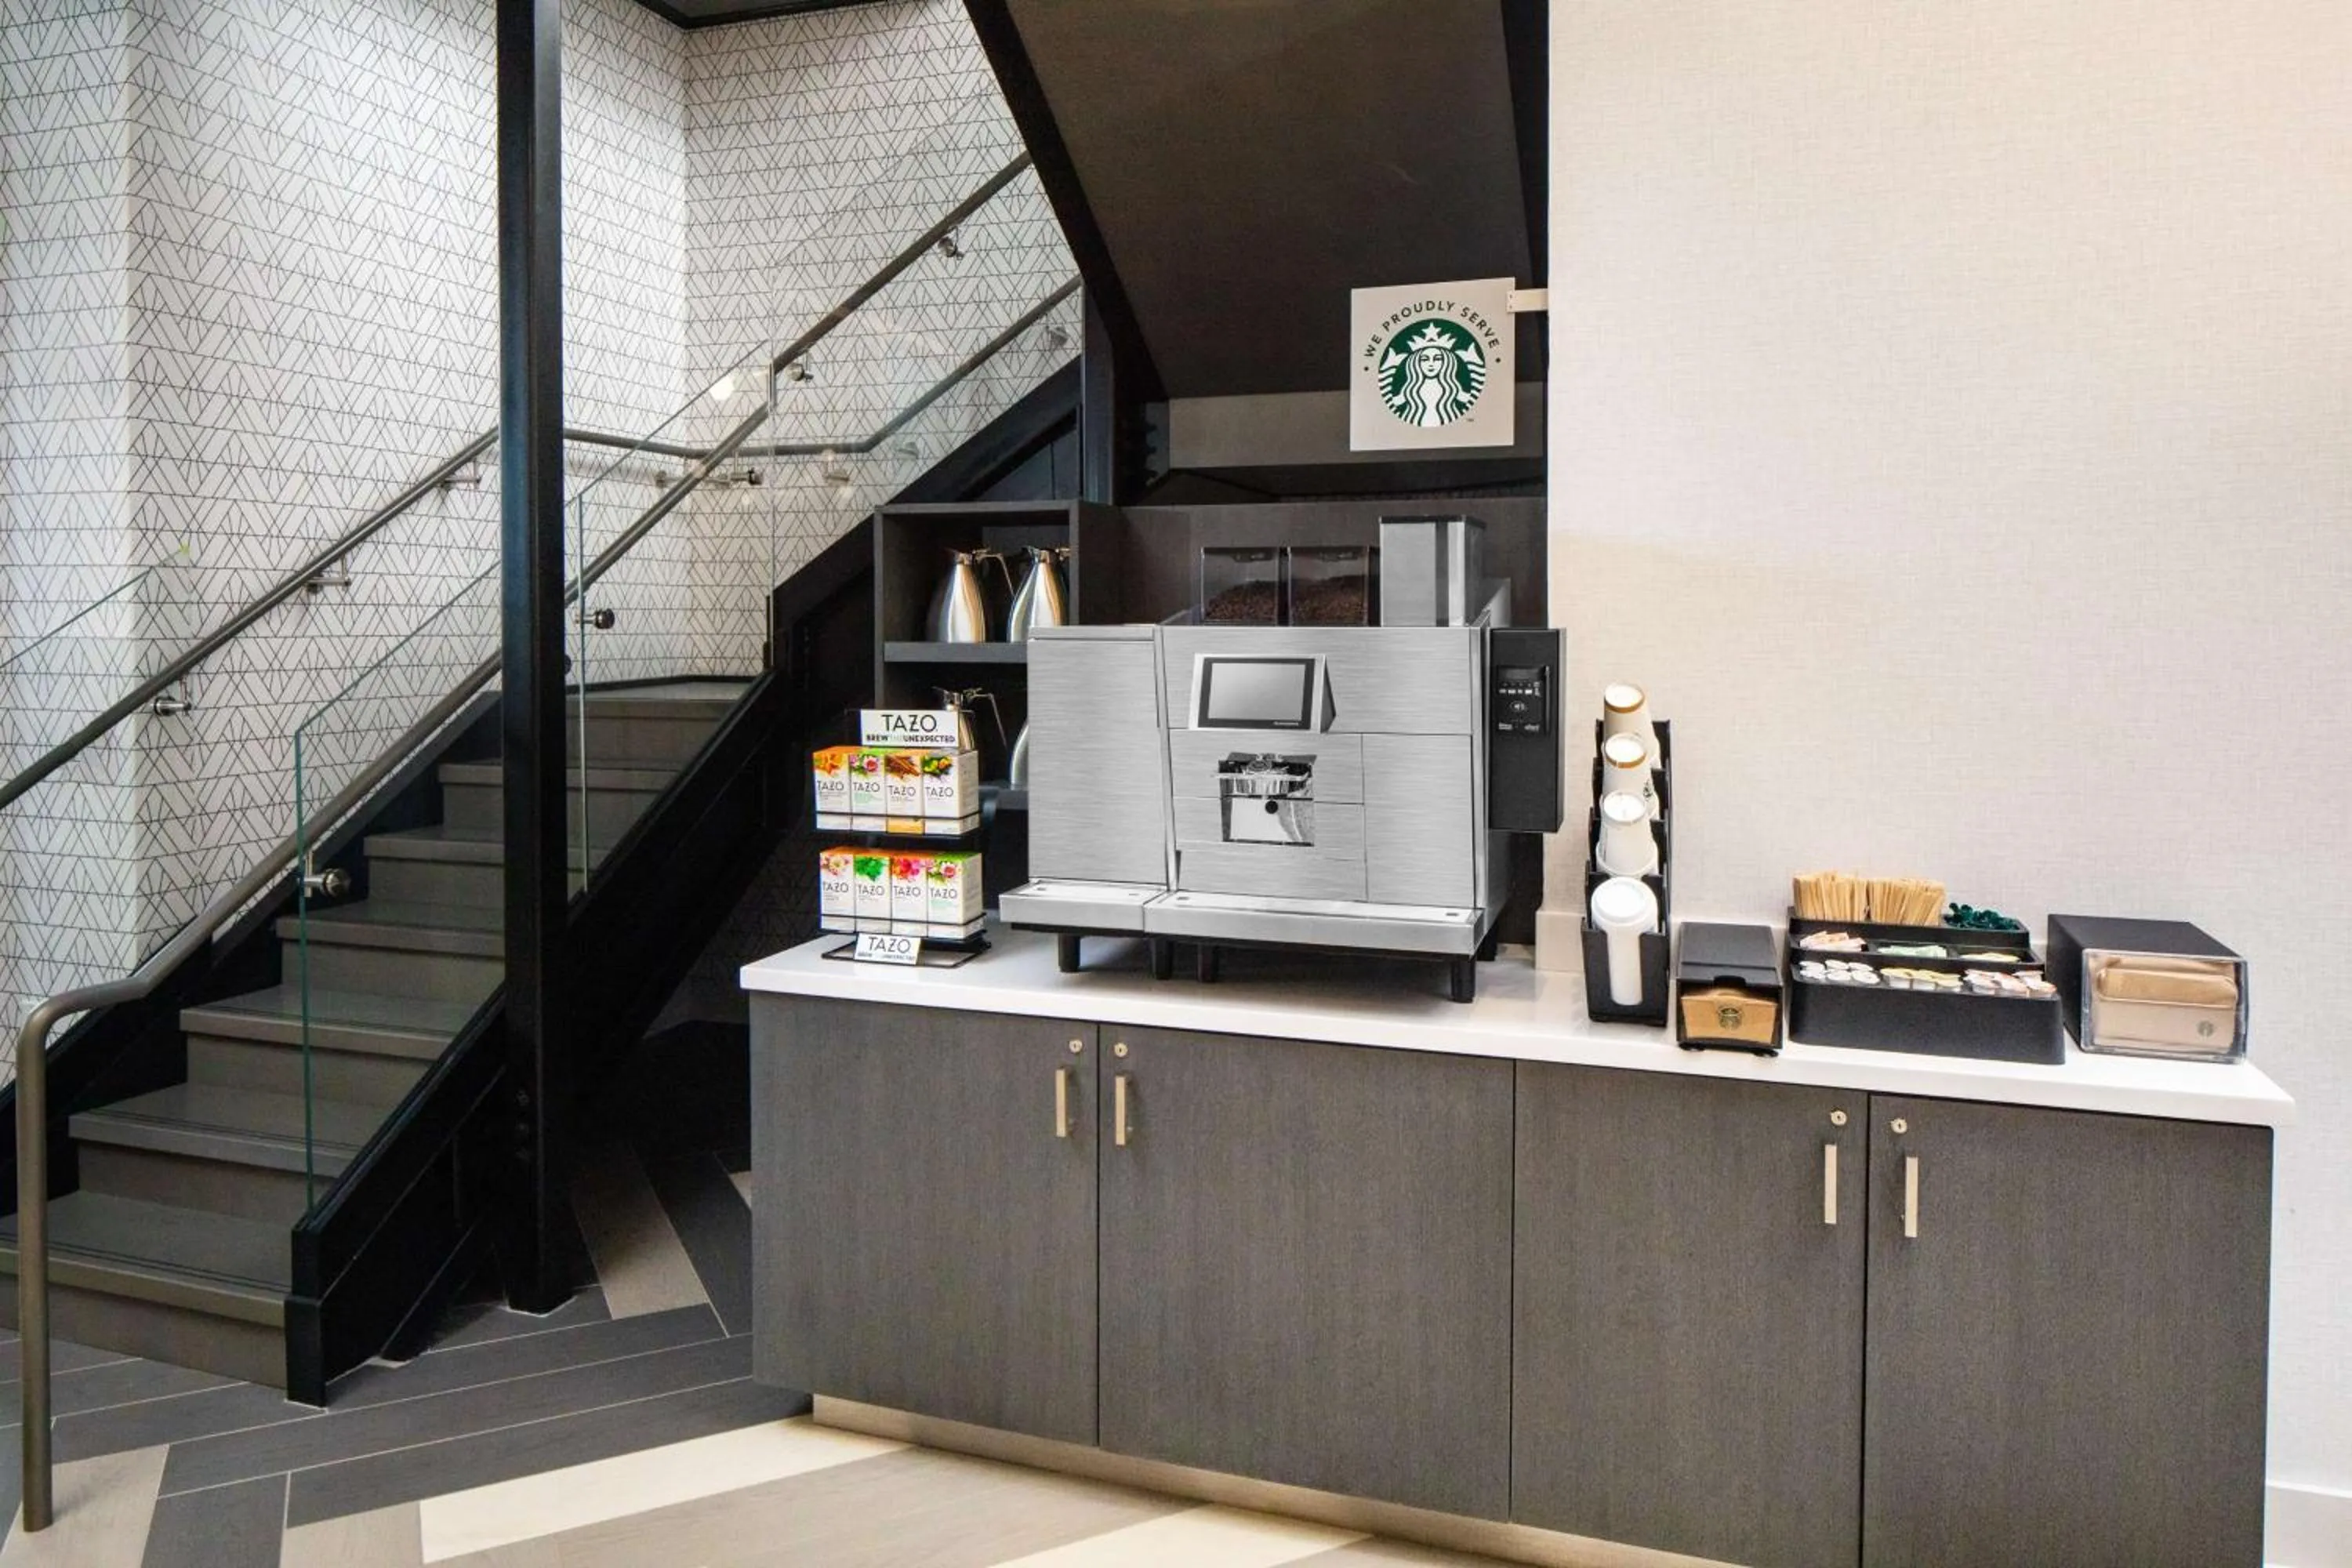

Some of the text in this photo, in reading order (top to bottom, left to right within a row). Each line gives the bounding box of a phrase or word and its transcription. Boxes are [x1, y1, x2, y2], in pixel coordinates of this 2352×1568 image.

[1365, 300, 1500, 357] WE PROUDLY SERVE
[880, 714, 937, 732] TAZO
[817, 780, 844, 791] TAZO
[853, 782, 880, 793] TAZO
[887, 785, 916, 797] TAZO
[925, 786, 954, 797] TAZO
[822, 881, 849, 893] TAZO
[857, 884, 885, 896] TAZO
[893, 885, 921, 897] TAZO
[929, 887, 957, 899] TAZO
[868, 935, 911, 954] TAZO
